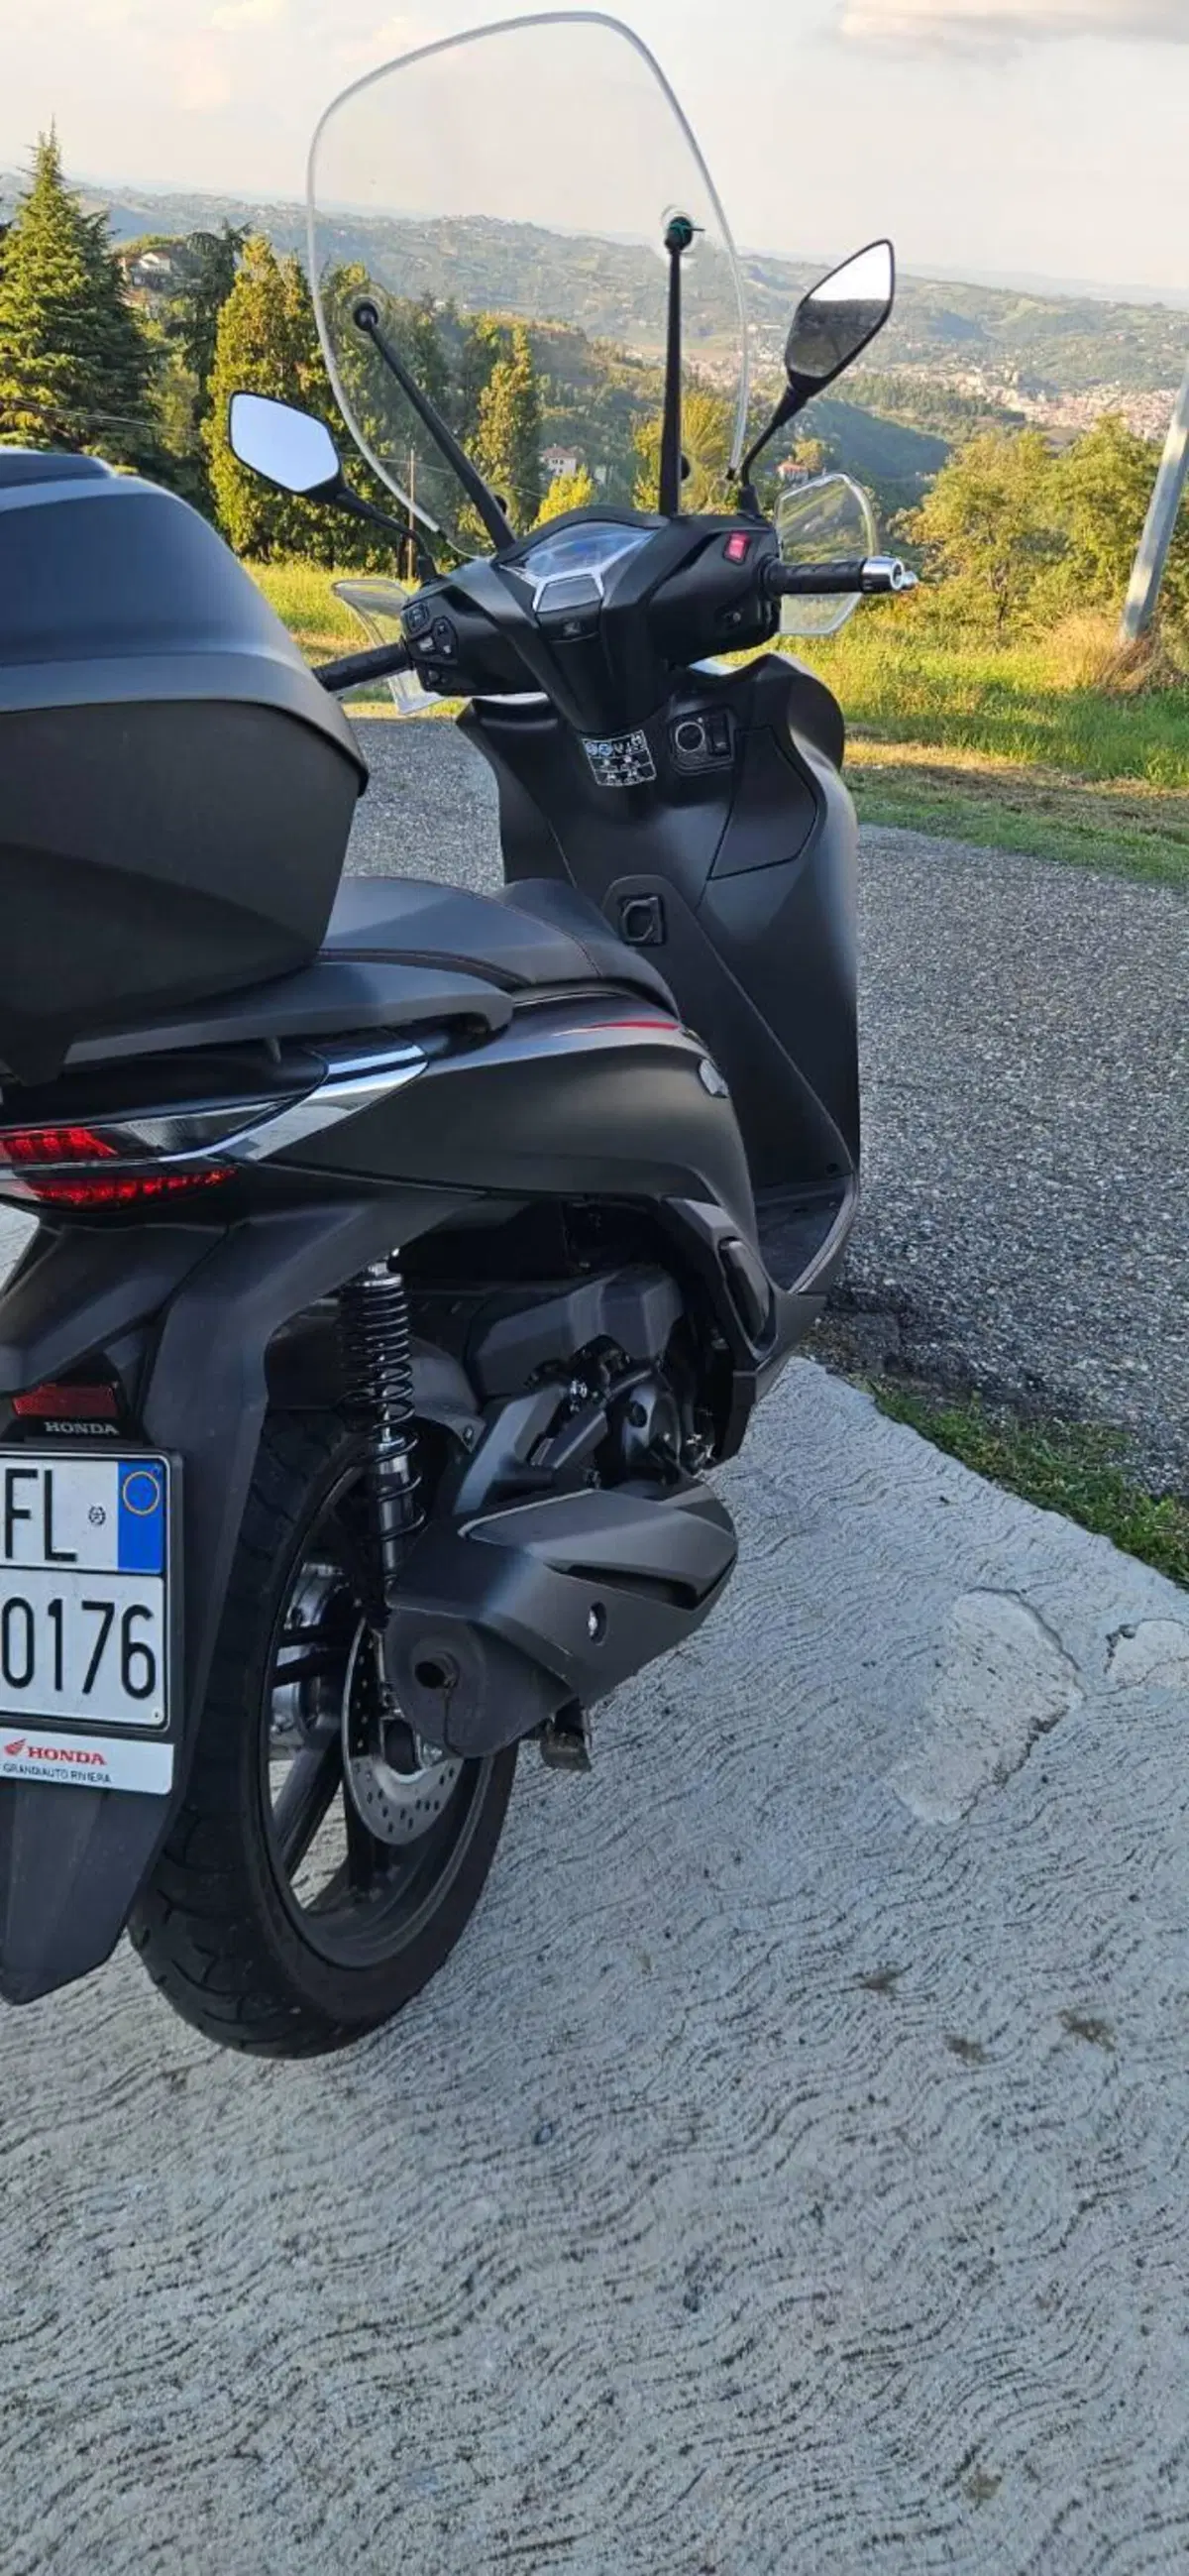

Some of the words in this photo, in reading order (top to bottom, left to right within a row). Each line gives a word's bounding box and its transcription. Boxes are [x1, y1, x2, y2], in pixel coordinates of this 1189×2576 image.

[44, 1421, 119, 1435] HONDA
[5, 1468, 77, 1562] FL
[1, 1596, 157, 1700] 0176
[28, 1746, 106, 1765] HONDA
[70, 1770, 112, 1783] RIVIERA
